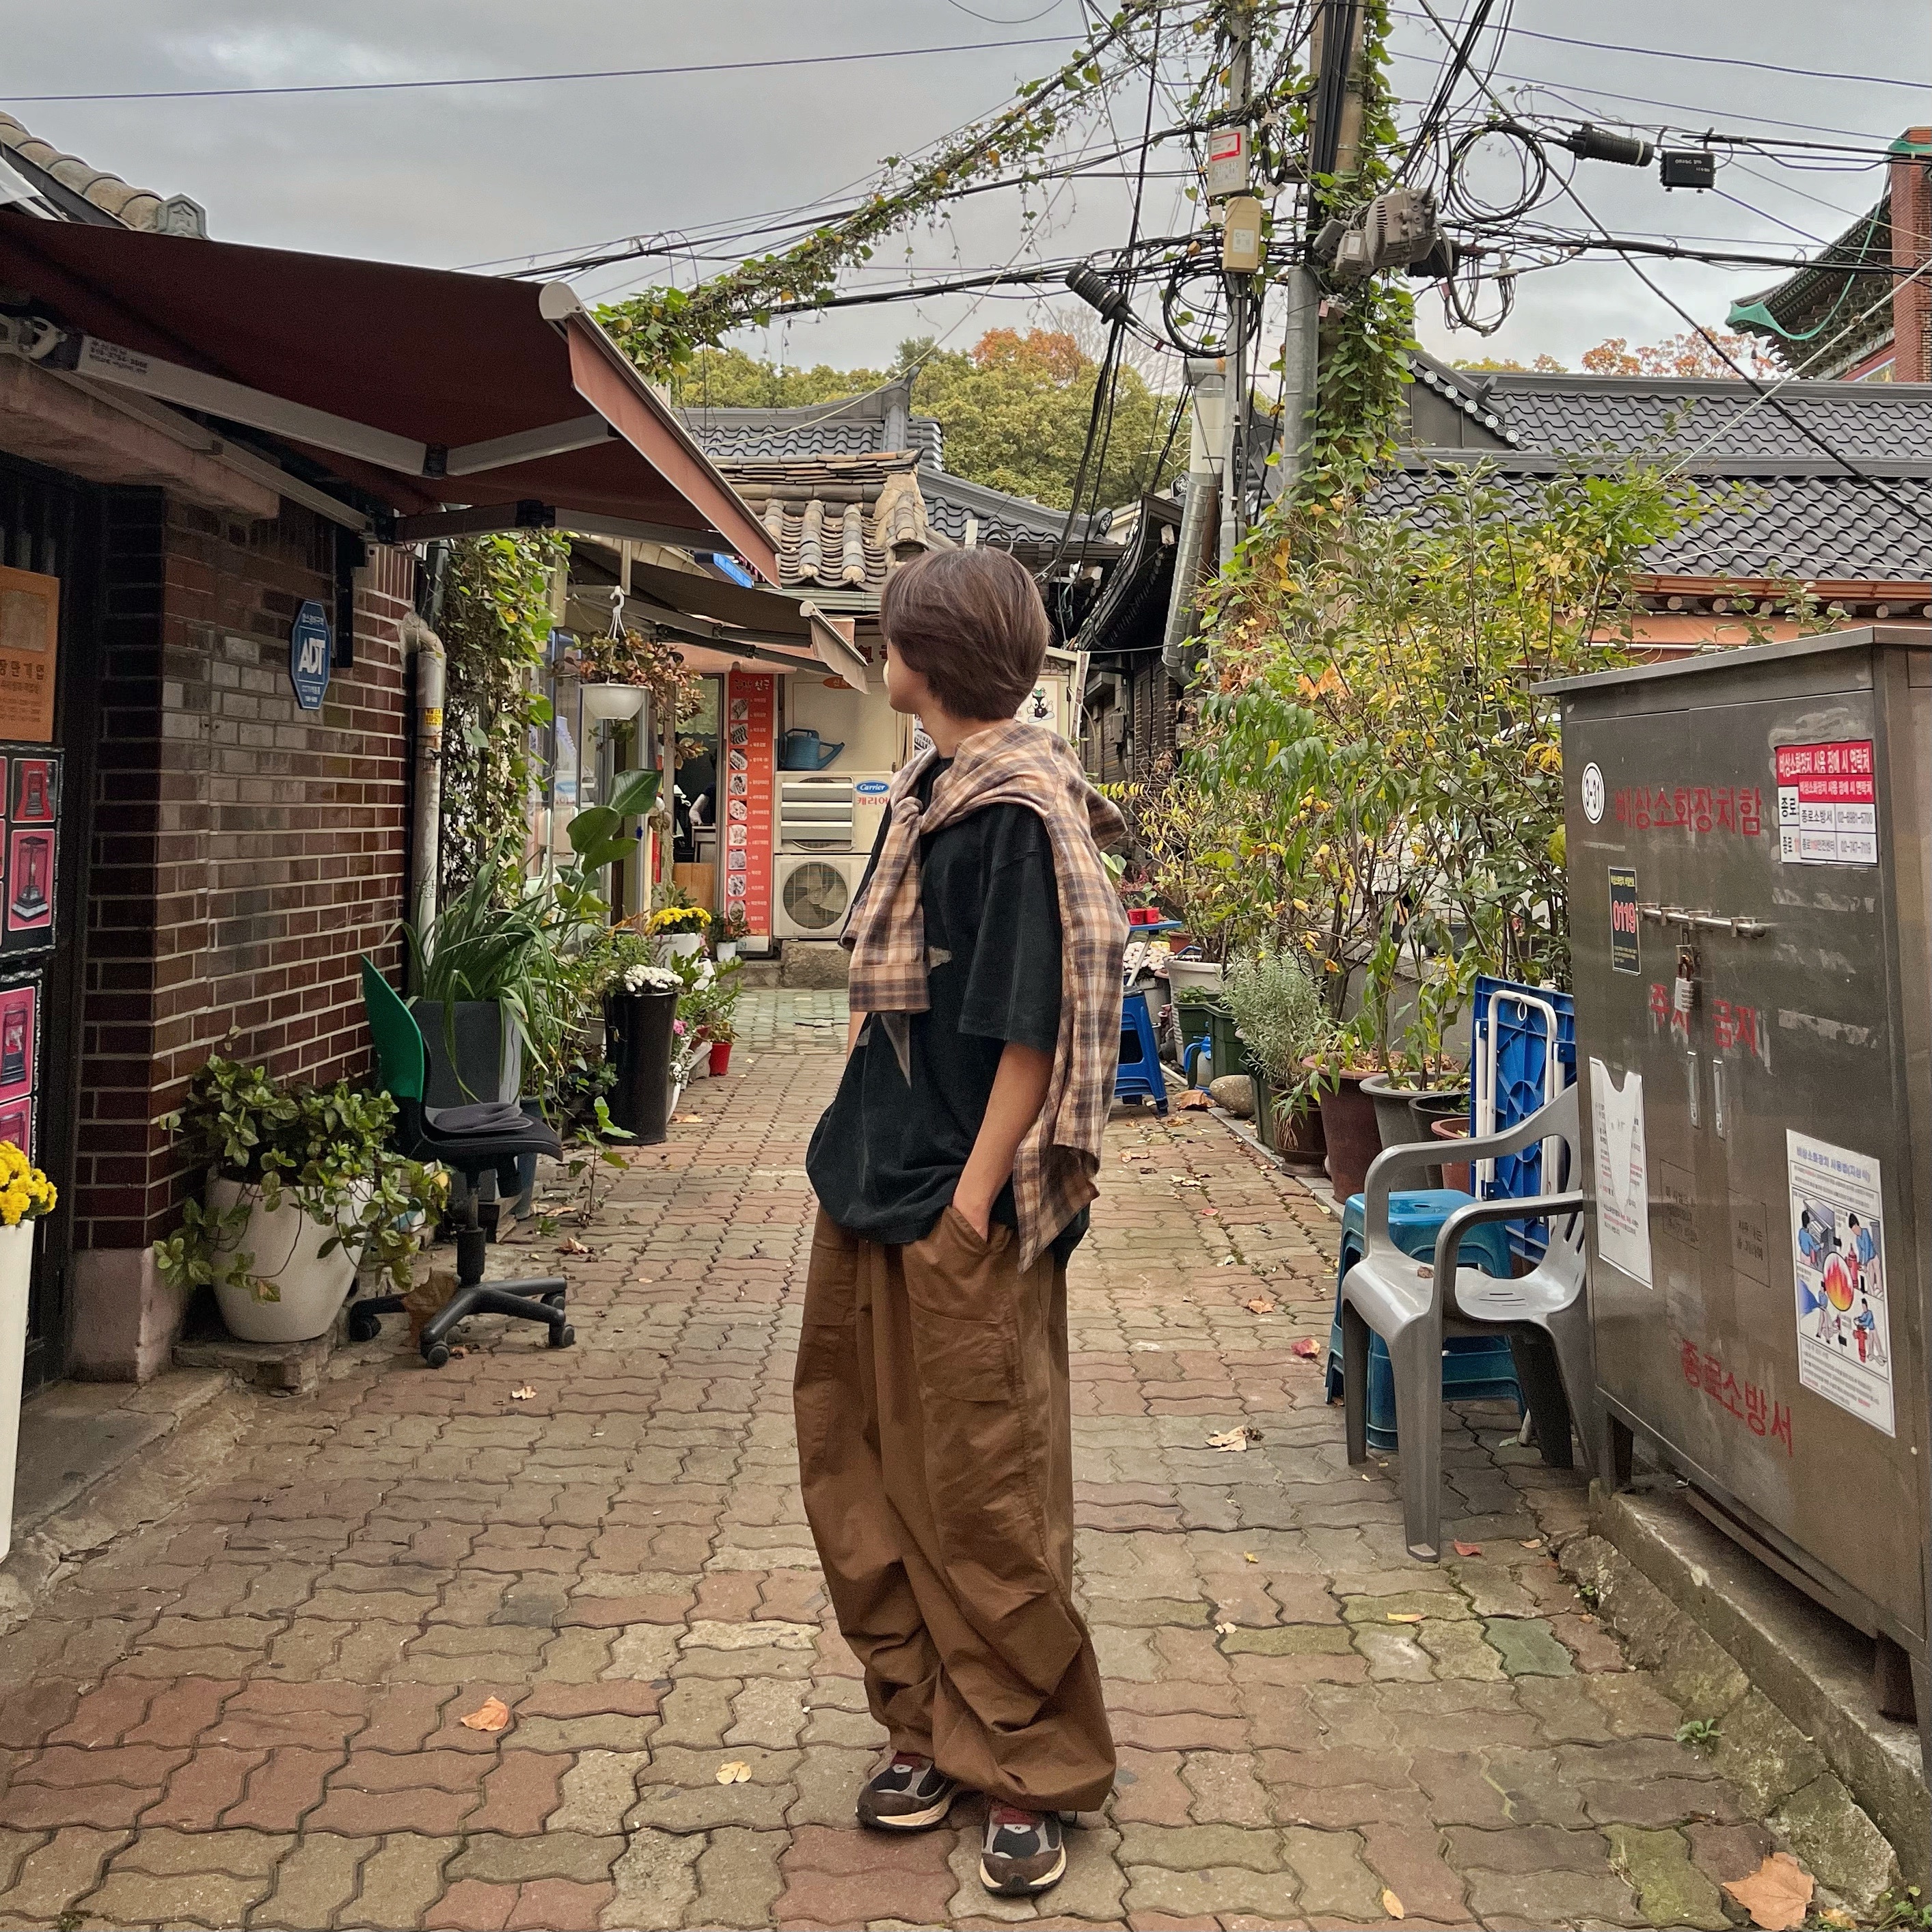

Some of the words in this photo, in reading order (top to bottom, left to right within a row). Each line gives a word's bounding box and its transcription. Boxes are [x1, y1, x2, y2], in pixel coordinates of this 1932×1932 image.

[298, 638, 326, 675] ADT
[856, 797, 888, 805] 캐리어
[1586, 777, 1601, 811] 3-31
[1801, 810, 1833, 824] 종로소방서
[1613, 900, 1636, 934] 0119
[1712, 999, 1756, 1057] 금지
[1682, 1337, 1793, 1457] 종로소방서
